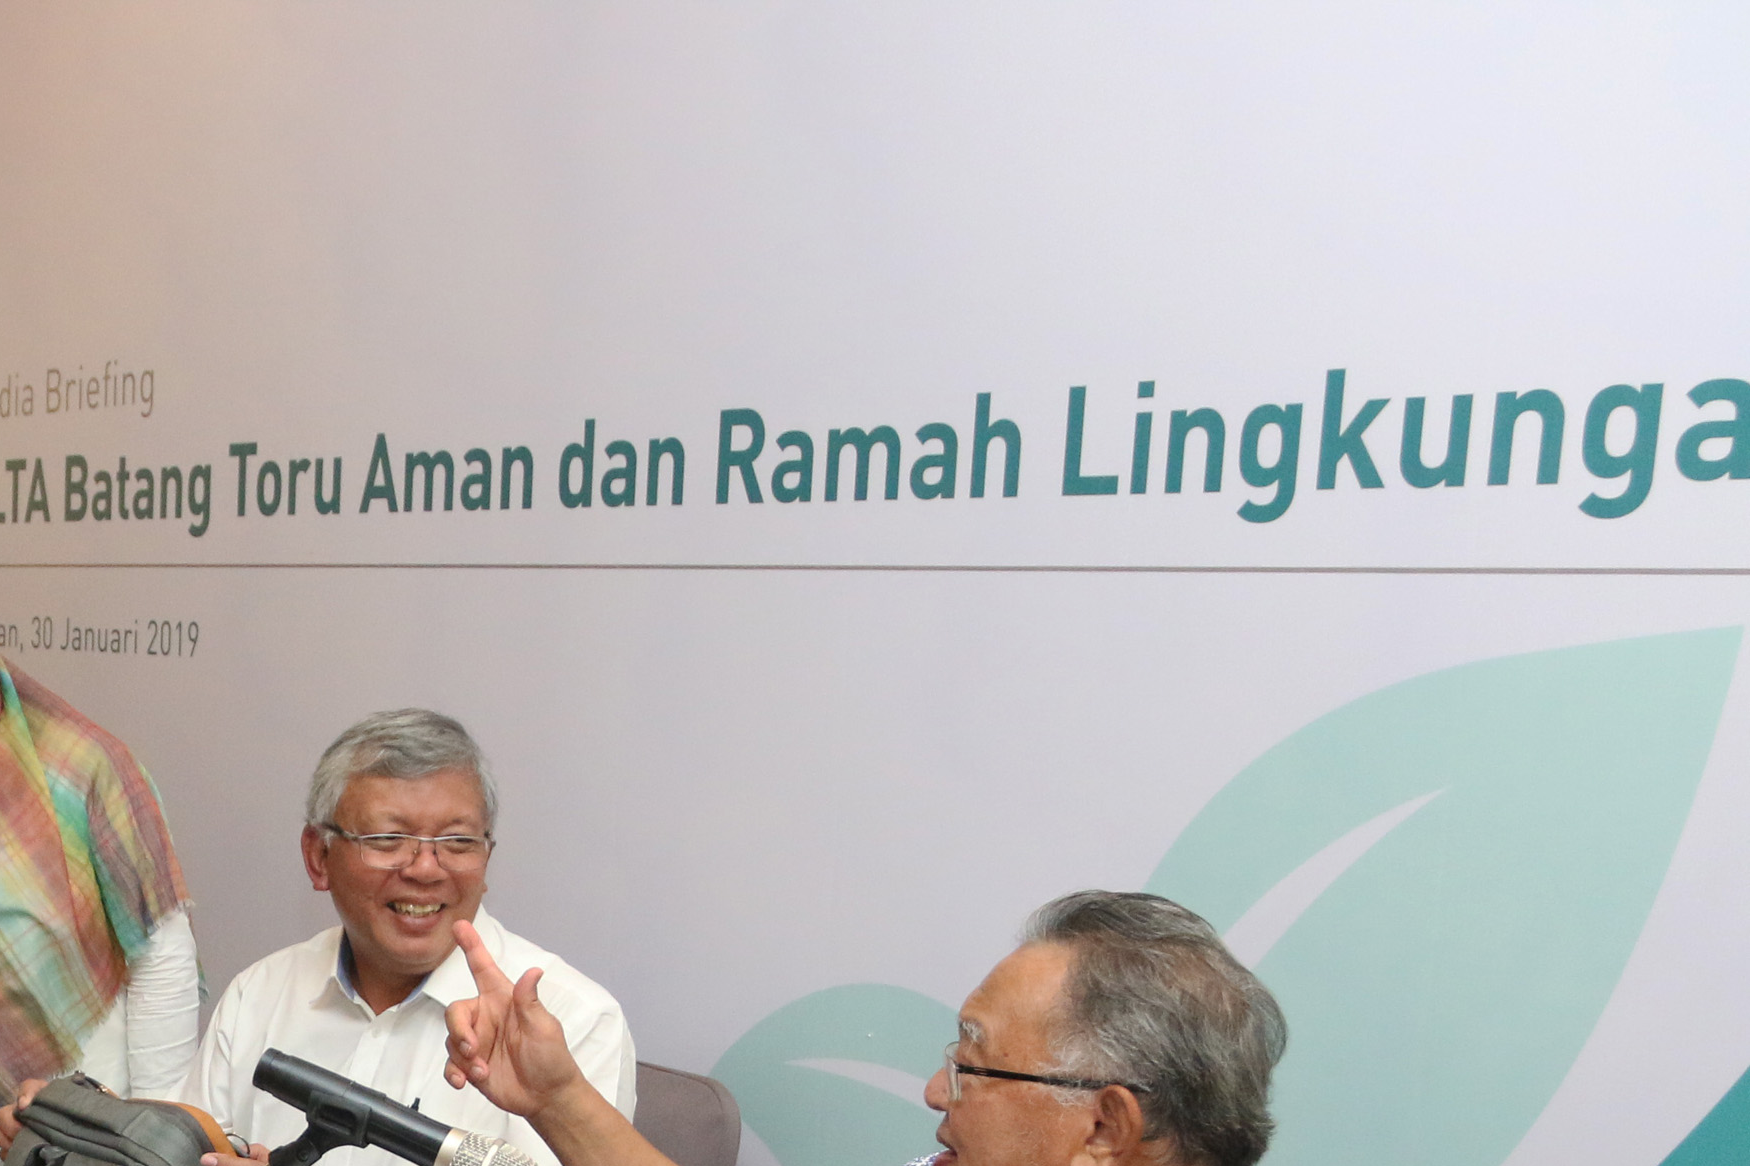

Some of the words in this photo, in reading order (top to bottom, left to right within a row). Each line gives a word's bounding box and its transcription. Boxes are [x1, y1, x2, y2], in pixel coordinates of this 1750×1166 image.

[46, 360, 154, 418] Briefing
[64, 454, 212, 538] Batang
[229, 441, 342, 518] Toru
[359, 432, 534, 514] Aman
[558, 418, 686, 508] dan
[716, 391, 1022, 505] Ramah
[1061, 368, 1750, 523] Lingkunga
[31, 616, 53, 650] 30
[60, 618, 138, 654] Januari
[146, 620, 200, 657] 2019
